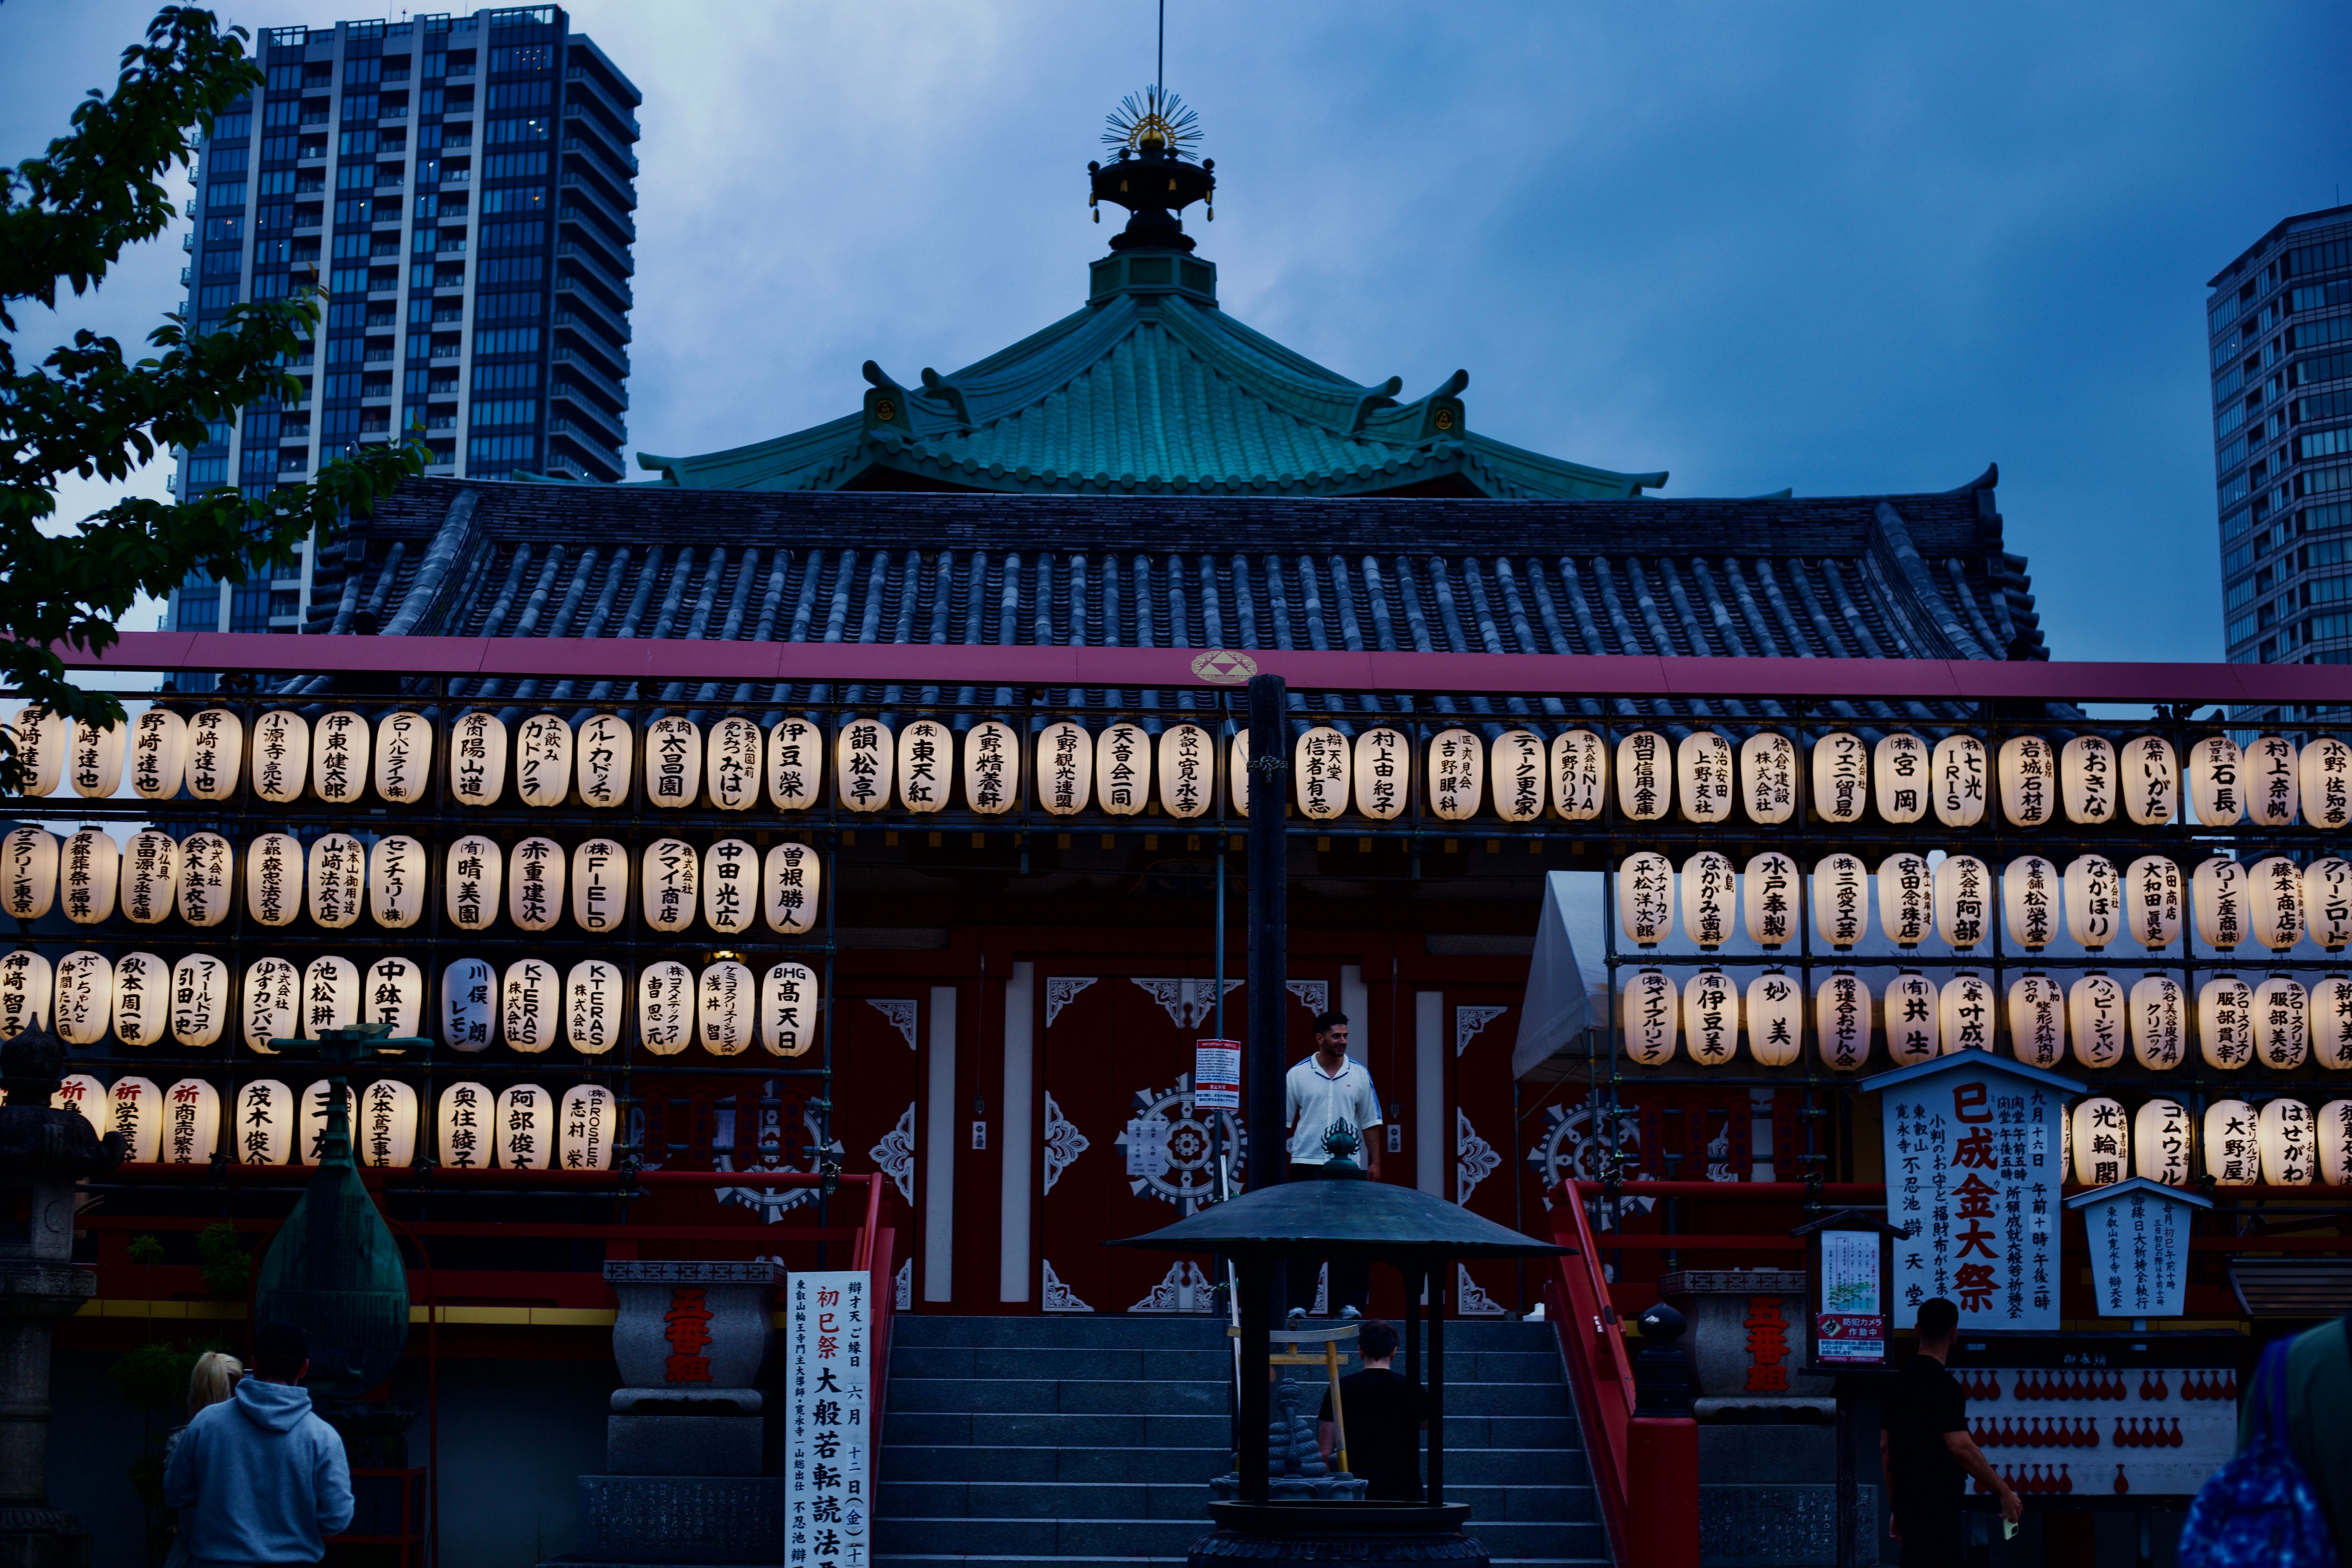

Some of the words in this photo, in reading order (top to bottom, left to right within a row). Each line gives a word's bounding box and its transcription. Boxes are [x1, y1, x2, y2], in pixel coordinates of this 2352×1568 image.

[263, 714, 288, 794] 小源寺亮太
[327, 716, 353, 798] 伊東健太郎
[460, 716, 487, 796] 焼肉陽山道
[523, 722, 542, 796] カドクラ
[544, 719, 561, 761] 立飲み
[655, 720, 692, 735] 焼肉
[658, 735, 687, 797] 太昌園
[743, 722, 757, 778] 上野公園前
[849, 726, 879, 805] 韻松亭
[908, 724, 937, 803] (株)東天紅
[2209, 740, 2223, 763] 四百年
[2224, 740, 2237, 763] 創業
[975, 726, 1004, 808] 上野精養軒
[1054, 726, 1078, 808] 上野観光連盟
[1111, 728, 1135, 806] 天音会一同
[1305, 738, 1330, 813] 信者有志
[1372, 731, 1395, 813] 村上由紀子
[1440, 740, 1458, 812] 吉野眼科
[1514, 735, 1537, 815] デューク更家
[1561, 740, 1578, 812] 上野のり子
[1632, 735, 1657, 815] 朝日信用金庫
[1694, 750, 1713, 813] 上野支社
[1712, 737, 1728, 798] 明治安田
[1754, 752, 1773, 812] 株式会社
[1773, 738, 1790, 805] 徳倉建設
[1891, 737, 1917, 812] (株)宮岡
[1945, 750, 1960, 810] IRIS
[1961, 738, 1982, 800] (株)七光
[2020, 741, 2042, 821] 岩城石材店
[2080, 738, 2107, 816] (株)おきな
[2143, 739, 2171, 817] 麻布いがた
[2210, 764, 2236, 813] 石長
[2265, 741, 2291, 818] 村上奈帆
[2322, 742, 2347, 823] 水野佐知香
[12, 830, 39, 912] サニクリーン東京
[132, 835, 159, 919] 吉田源之丞老舗
[184, 838, 209, 921] 鈴木法衣店
[208, 839, 224, 886] 株式会社
[260, 836, 282, 921] 京都森忠法衣店
[382, 839, 407, 921] センチュリー(株)
[457, 842, 484, 923] (有)晴美園
[521, 842, 550, 922] 赤重建次
[585, 843, 613, 928] (株)FIELD
[658, 843, 681, 922] クマイ商店
[682, 847, 694, 894] 株式会社
[716, 842, 743, 927] 中田光広
[1632, 860, 1654, 937] 平松洋次郎
[1699, 855, 1723, 941] なかがみ歯科
[1833, 858, 1858, 938] (株)三愛工芸
[1899, 858, 1922, 937] 安田念珠店
[1952, 859, 1982, 941] 株式会社阿部
[2087, 860, 2109, 937] なかほり
[2164, 863, 2177, 920] 戸田商店
[2213, 860, 2240, 943] グリーン産商(株)
[2271, 863, 2297, 943] 藤本商店(株)
[2322, 861, 2352, 943] グリーンロード
[58, 962, 74, 1037] 仲間たち一同
[74, 956, 99, 1023] ポンちゃんと
[120, 959, 146, 1040] 秋本周一郎
[175, 968, 194, 1035] 引田一史
[193, 961, 216, 1032] フィールドコア
[251, 962, 275, 1046] ゆずカンパニー
[275, 963, 291, 1010] 株式会社
[310, 962, 337, 1032] 池松耕
[507, 982, 521, 1042] 株式会社
[521, 965, 541, 1044] KTERAS
[589, 965, 604, 1046] KTERAS
[774, 968, 805, 980] BHG
[2024, 980, 2038, 1003] やつか
[450, 1001, 468, 1045] レモン
[573, 984, 587, 1042] 株式会社
[1697, 975, 1727, 1057] (有)伊豆美
[1763, 981, 1792, 1045] 妙美
[1902, 980, 1929, 1055] (有)共生
[2088, 980, 2115, 1062] ハッピージャパン
[2146, 1004, 2162, 1060] クリニック
[2161, 981, 2178, 1063] 渋谷美容皮膚科
[2216, 992, 2236, 1064] 服部貫宰
[2269, 992, 2289, 1063] 服部美香
[1895, 1104, 1911, 1153] 寛永寺
[1913, 1104, 1929, 1152] 東叡山
[2161, 1106, 2183, 1185] コムウェル
[2222, 1117, 2246, 1180] 大野屋
[2282, 1105, 2304, 1182] はせがわ
[1929, 1115, 1950, 1300] 小判のお守と、福財布が出ま
[1951, 1082, 2001, 1312] 巳成金大祭
[816, 1286, 840, 1359] 初巳祭
[1843, 1318, 1882, 1326] 防犯カメラ
[791, 1502, 806, 1568] 不忍池辯
